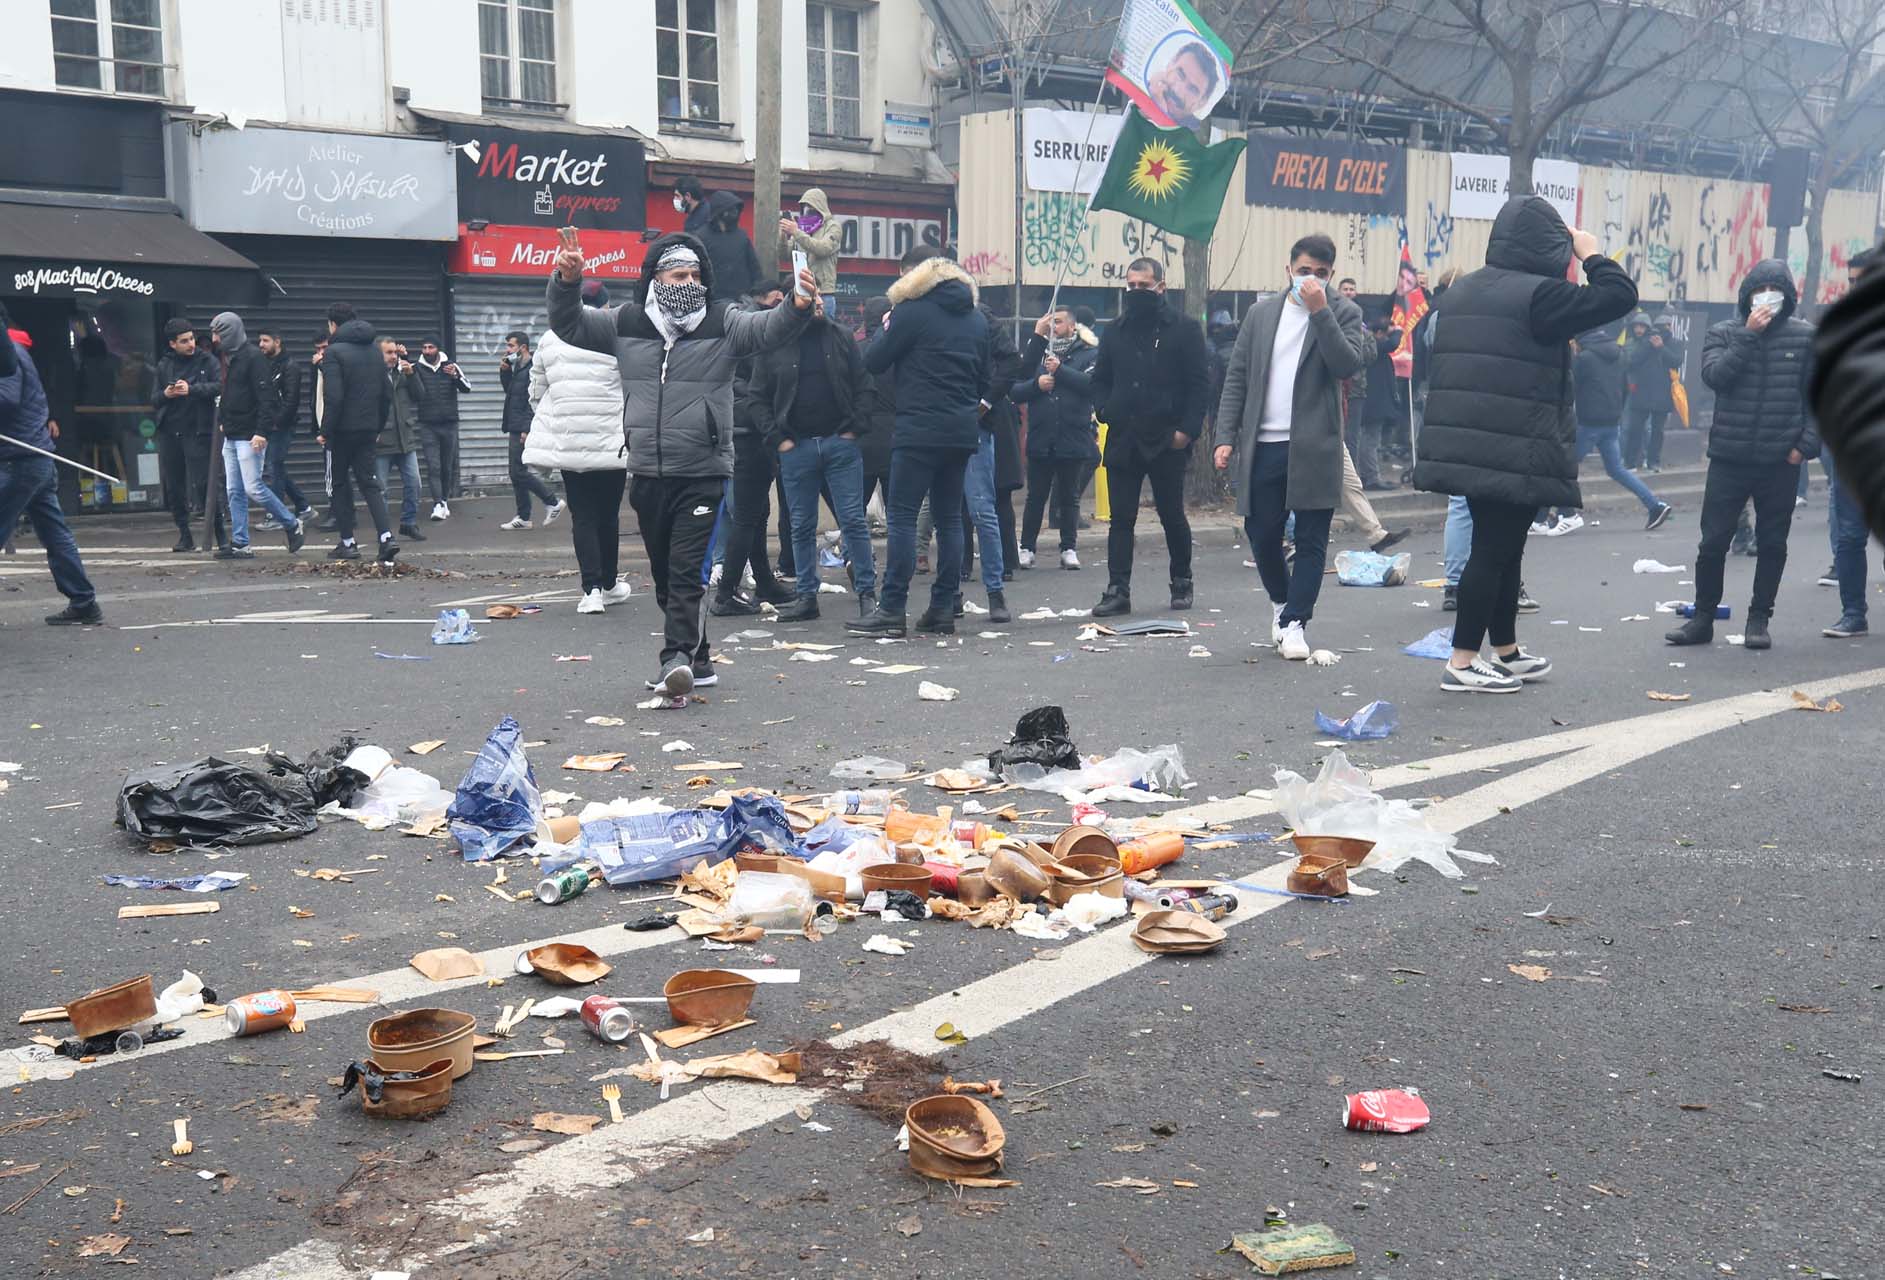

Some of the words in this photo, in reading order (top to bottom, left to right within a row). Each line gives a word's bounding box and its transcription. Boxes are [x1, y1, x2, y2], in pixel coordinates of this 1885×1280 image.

[308, 144, 363, 165] Atelier
[1034, 139, 1111, 162] SERRURIE
[478, 142, 608, 187] Market
[1272, 151, 1328, 191] PREYA
[1334, 158, 1388, 195] CYCLE
[1455, 175, 1498, 194] LAVERIE
[297, 204, 375, 230] Créations
[555, 193, 621, 224] express
